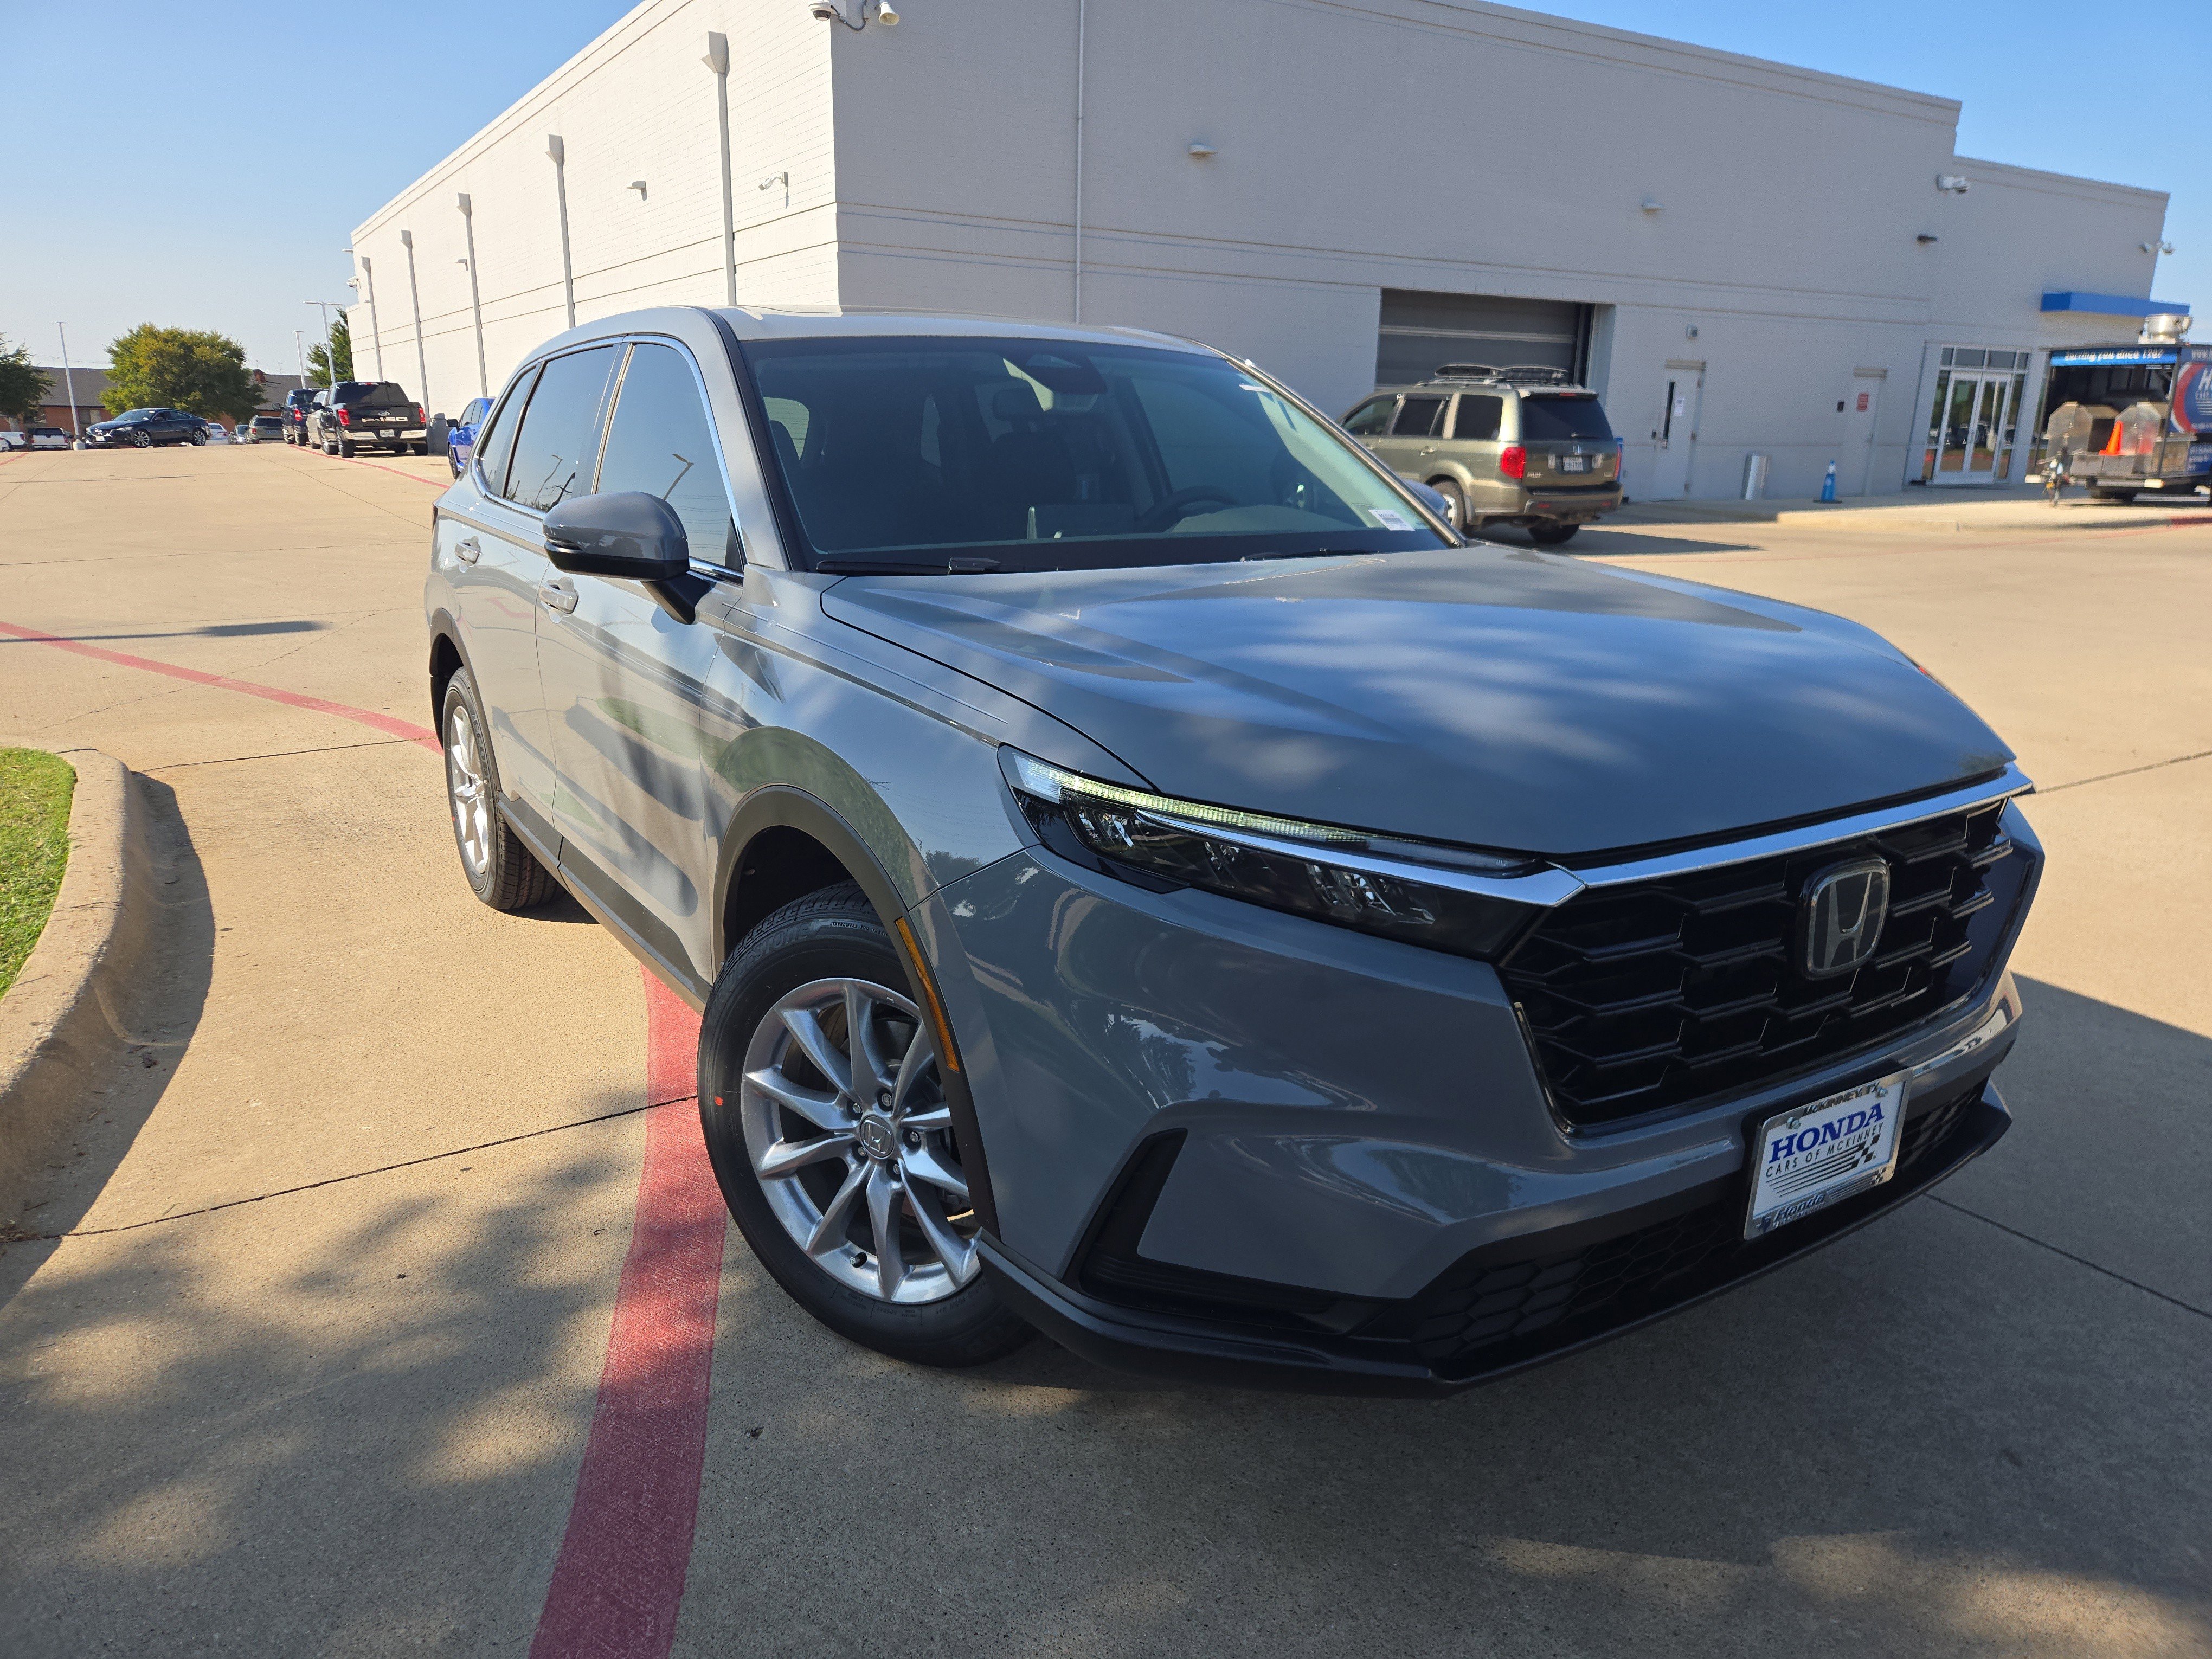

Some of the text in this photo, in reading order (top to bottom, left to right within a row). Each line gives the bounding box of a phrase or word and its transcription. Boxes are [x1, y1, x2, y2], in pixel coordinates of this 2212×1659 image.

[2065, 350, 2096, 362] Serving
[2097, 351, 2114, 362] you
[2115, 350, 2139, 359] since
[2198, 368, 2212, 391] H
[1769, 1102, 1885, 1164] HONDA
[1766, 1121, 1884, 1178] CARS OF MCKINNEY
[1773, 1193, 1825, 1222] Honda
